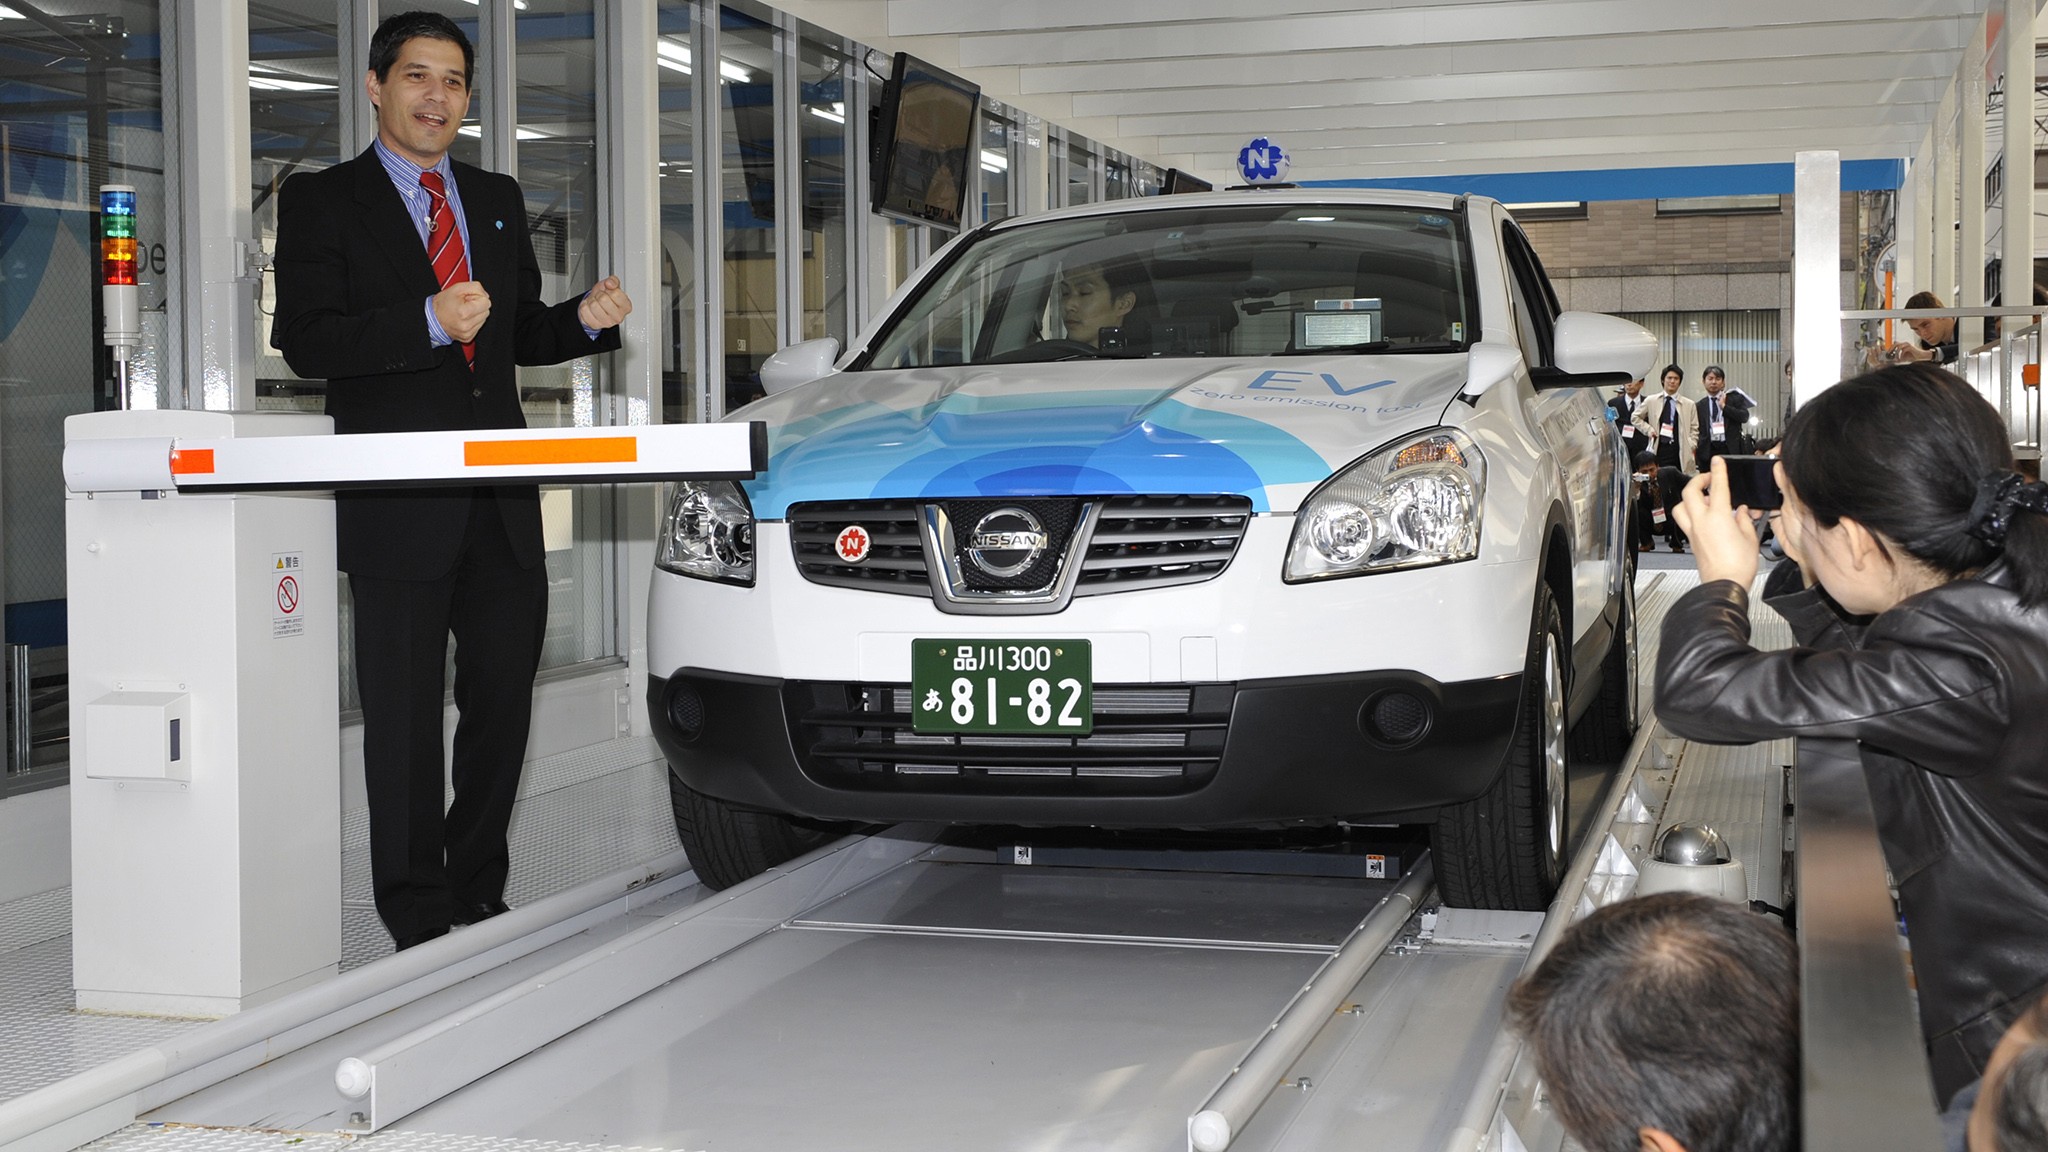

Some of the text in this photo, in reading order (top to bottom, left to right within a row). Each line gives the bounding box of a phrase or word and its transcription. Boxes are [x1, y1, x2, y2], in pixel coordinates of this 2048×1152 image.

[1248, 148, 1270, 169] N
[1247, 370, 1398, 396] EV
[1190, 386, 1423, 414] zero emission taxi
[846, 537, 859, 550] N
[972, 535, 1037, 546] NISSAN
[953, 646, 1051, 671] 品川300
[922, 677, 1083, 727] あ 81-82
